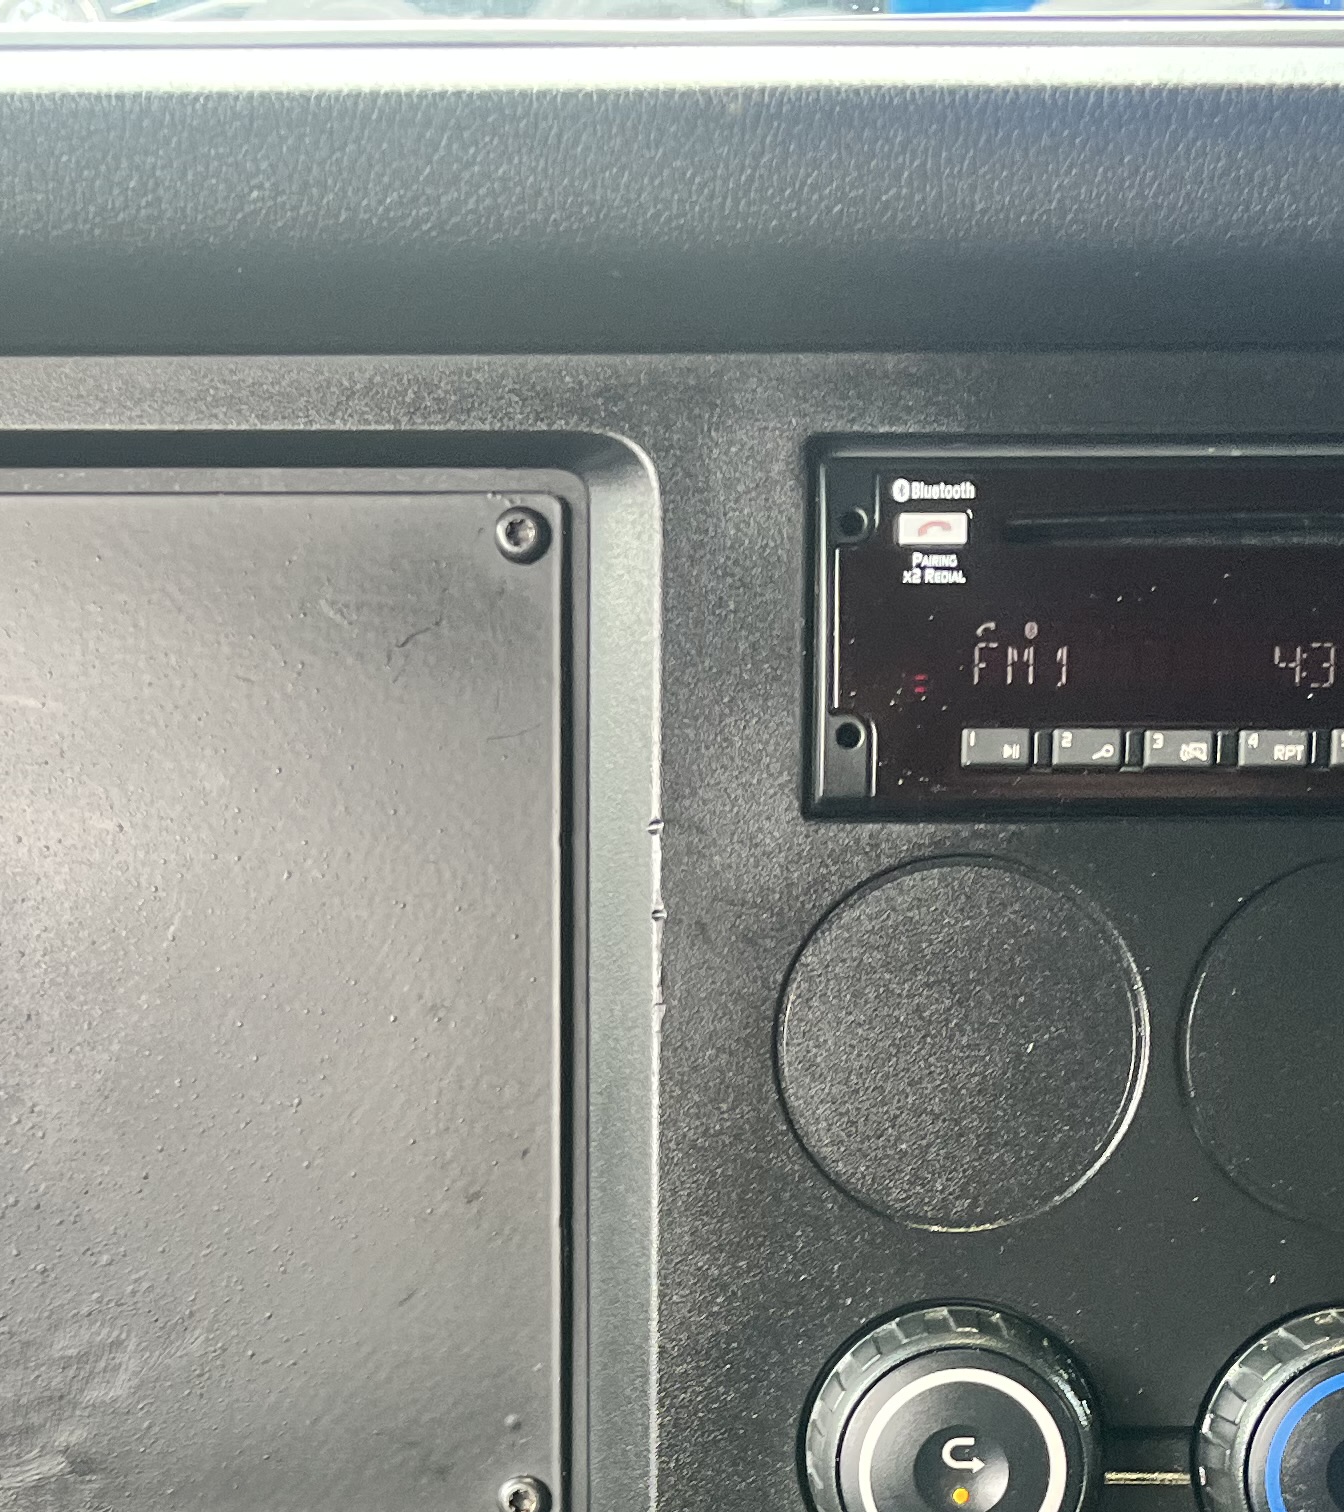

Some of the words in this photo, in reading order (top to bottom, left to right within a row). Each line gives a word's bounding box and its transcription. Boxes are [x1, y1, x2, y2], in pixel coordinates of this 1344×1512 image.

[911, 481, 976, 500] Bluetooth
[968, 730, 976, 747] 1
[1061, 731, 1073, 748] 2
[1152, 732, 1164, 749] 3
[1247, 732, 1259, 748] 4
[1273, 743, 1305, 761] RPT
